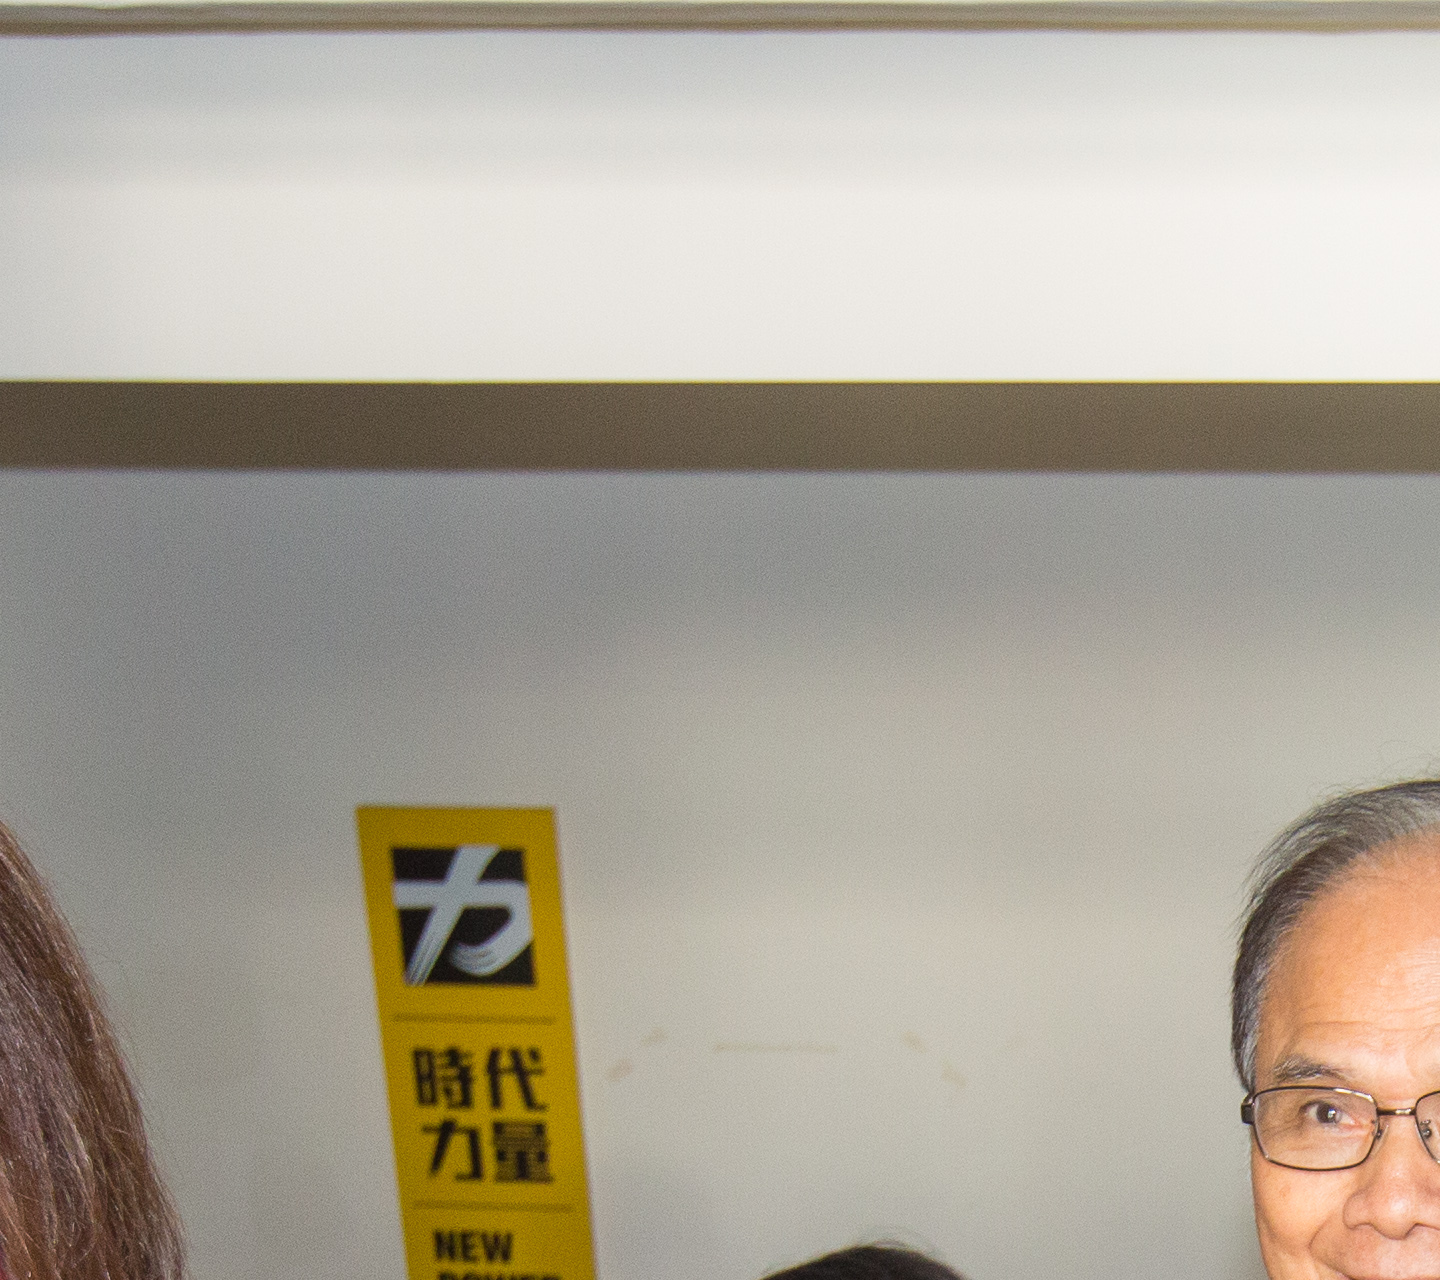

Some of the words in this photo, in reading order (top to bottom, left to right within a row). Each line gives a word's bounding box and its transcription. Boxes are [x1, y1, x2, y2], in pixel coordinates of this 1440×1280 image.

[413, 1048, 549, 1112] 時代
[422, 1118, 554, 1184] 力量
[434, 1229, 513, 1264] NEW
